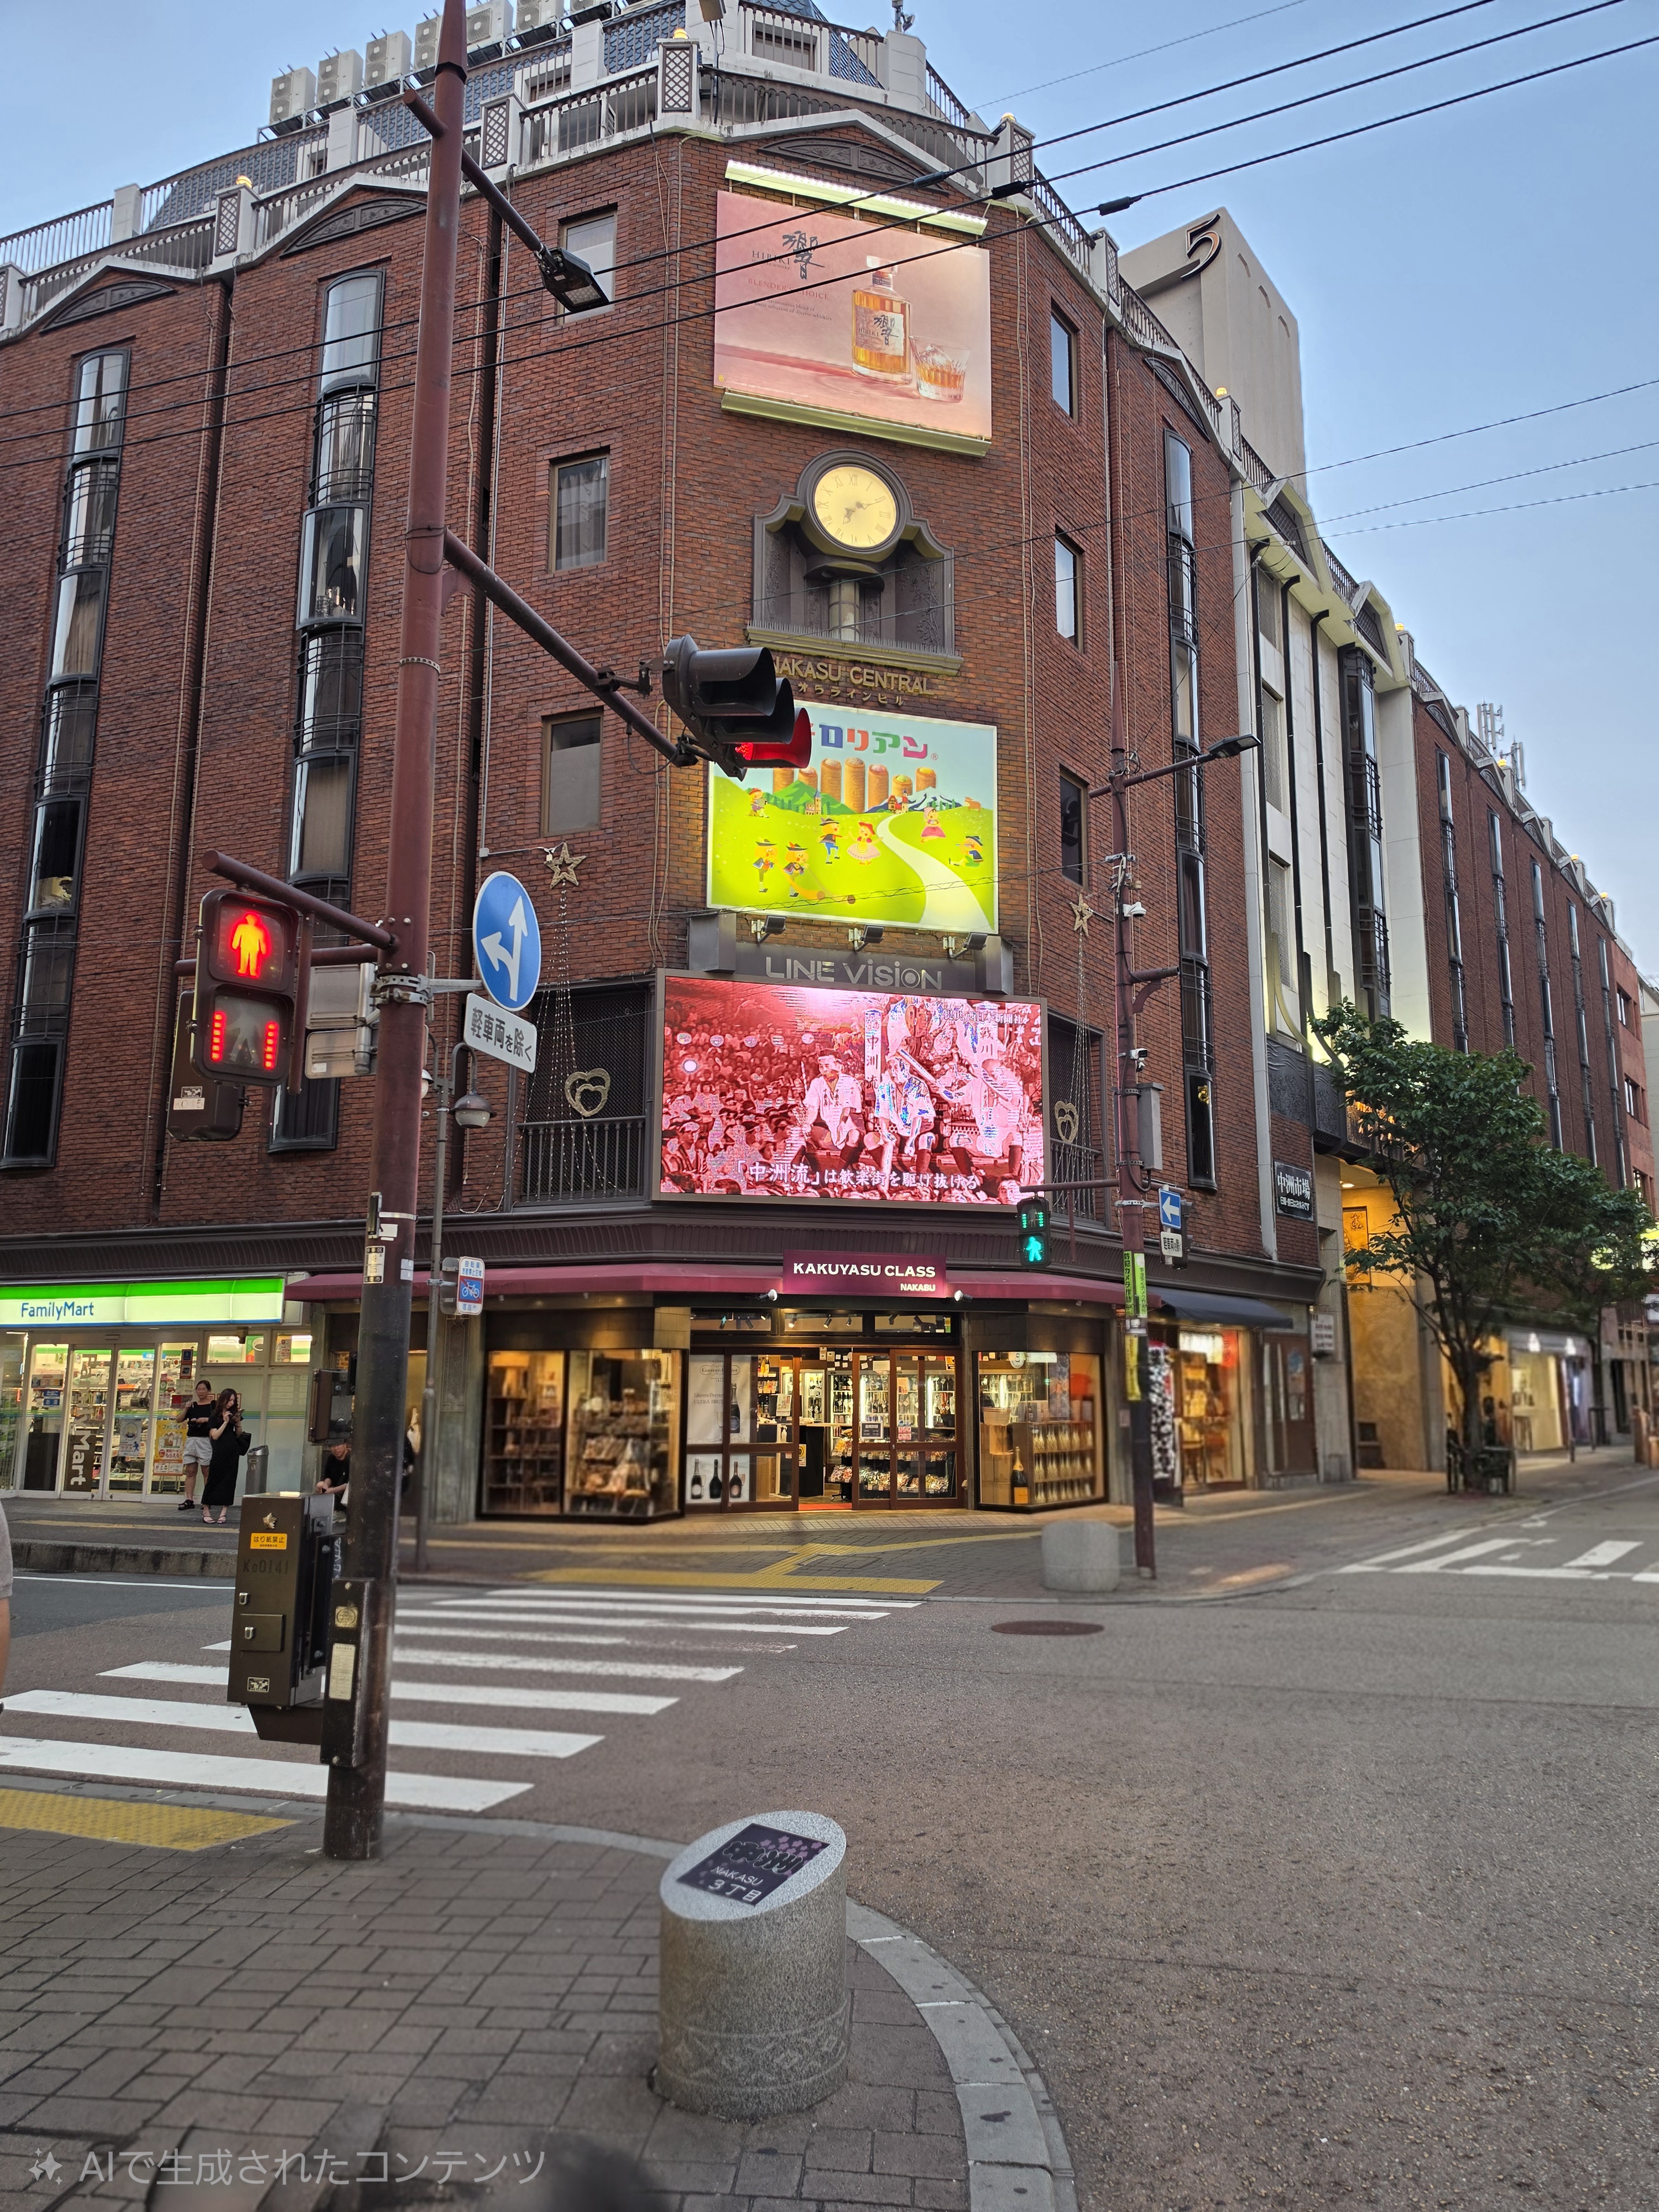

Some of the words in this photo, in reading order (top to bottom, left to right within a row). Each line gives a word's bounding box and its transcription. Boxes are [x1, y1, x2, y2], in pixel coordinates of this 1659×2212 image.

[1181, 213, 1222, 281] 5
[859, 327, 879, 337] HIBIKI
[850, 666, 935, 696] CENTRAL
[811, 723, 928, 759] ロリアン
[766, 956, 834, 982] LINE
[471, 1007, 531, 1062] 軽車両を除く
[737, 1160, 978, 1190] 「中洲流」は歓楽街を駆け抜ける
[1277, 1172, 1311, 1200] 中洲市場
[794, 1263, 881, 1276] KAKUYASU
[885, 1265, 936, 1278] CLASS
[900, 1283, 936, 1291] NAKASU
[21, 1301, 94, 1321] FamilyMart
[722, 1841, 804, 1874] 中洲
[711, 1866, 764, 1886] NAKASU
[708, 1880, 762, 1902] 3丁目
